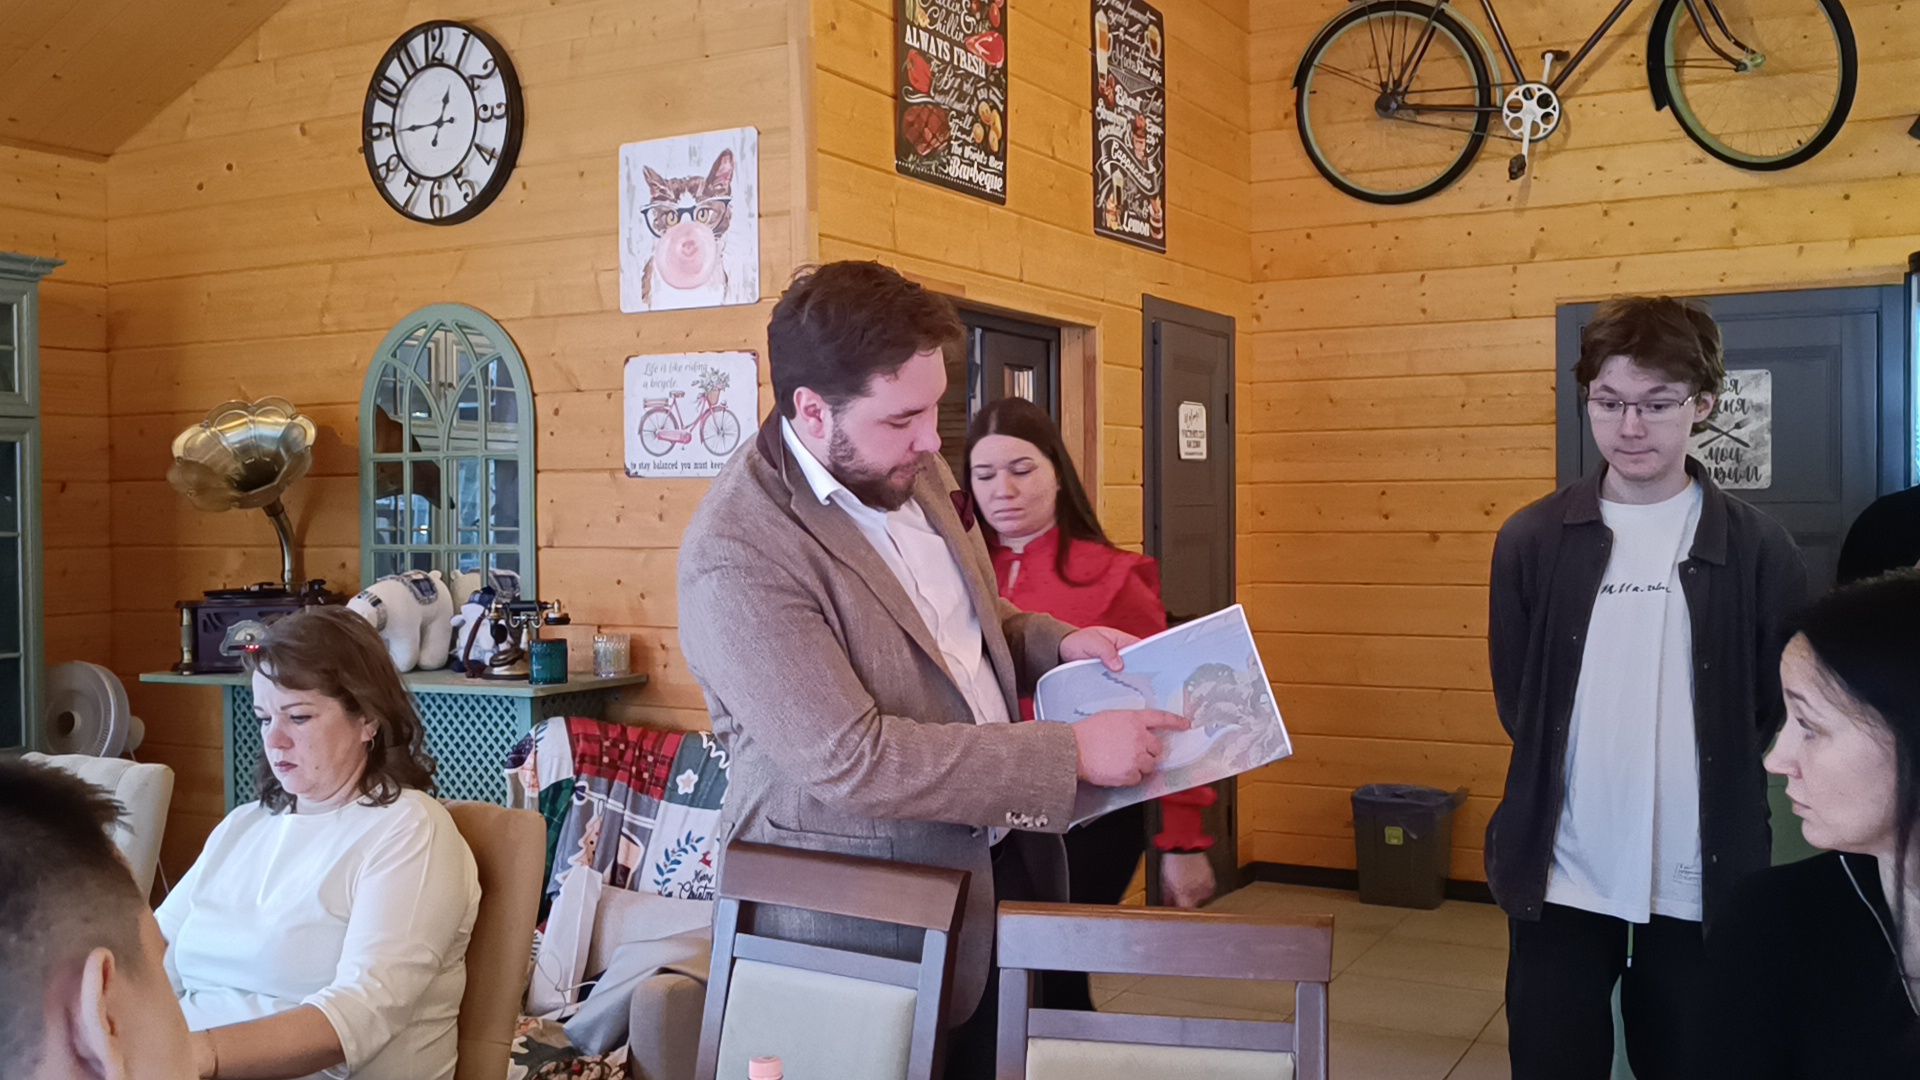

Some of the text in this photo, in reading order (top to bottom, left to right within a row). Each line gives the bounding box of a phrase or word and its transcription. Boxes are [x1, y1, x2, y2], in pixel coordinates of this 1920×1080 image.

[424, 27, 445, 62] 12
[905, 24, 950, 62] ALWAYS
[953, 45, 986, 79] FRESH
[478, 101, 507, 123] 3
[474, 142, 499, 165] 4
[452, 166, 476, 203] 5
[949, 156, 1003, 193] Barbeque
[430, 180, 444, 219] 6
[1123, 211, 1150, 236] Lemon
[644, 362, 657, 376] Life
[669, 362, 682, 373] like
[639, 461, 651, 471] stay
[653, 459, 678, 469] balanced
[680, 461, 691, 471] you
[694, 461, 708, 469] must
